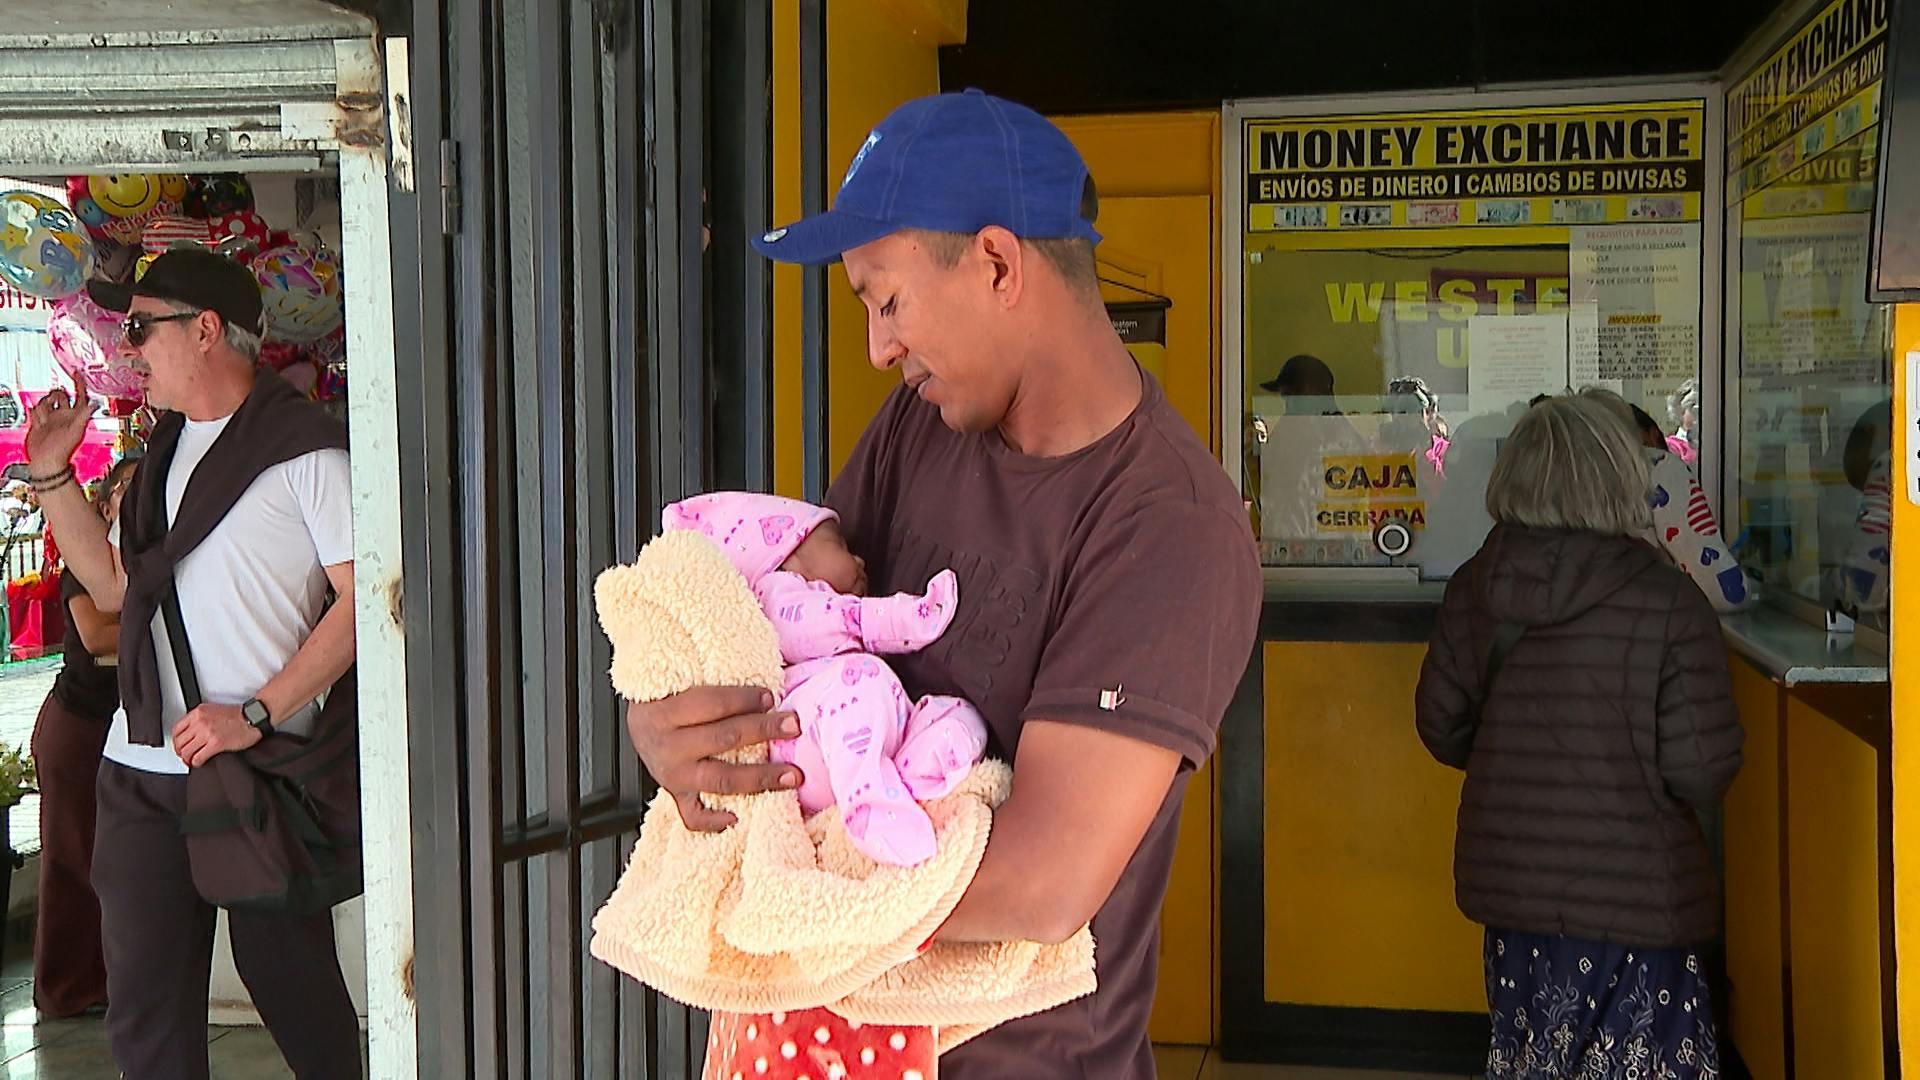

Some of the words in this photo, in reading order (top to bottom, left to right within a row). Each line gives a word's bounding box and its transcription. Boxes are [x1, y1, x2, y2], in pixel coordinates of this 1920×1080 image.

[1843, 60, 1857, 94] DE
[1260, 127, 1423, 170] MONEY
[1436, 117, 1690, 164] EXCHANGE
[1260, 174, 1333, 199] ENVÍOS
[1340, 176, 1366, 197] DE
[1373, 175, 1448, 197] DINERO
[1467, 171, 1561, 194] CAMBIOS
[1568, 171, 1595, 191] DE
[1602, 167, 1688, 191] DIVISAS
[1324, 464, 1417, 490] CAJA
